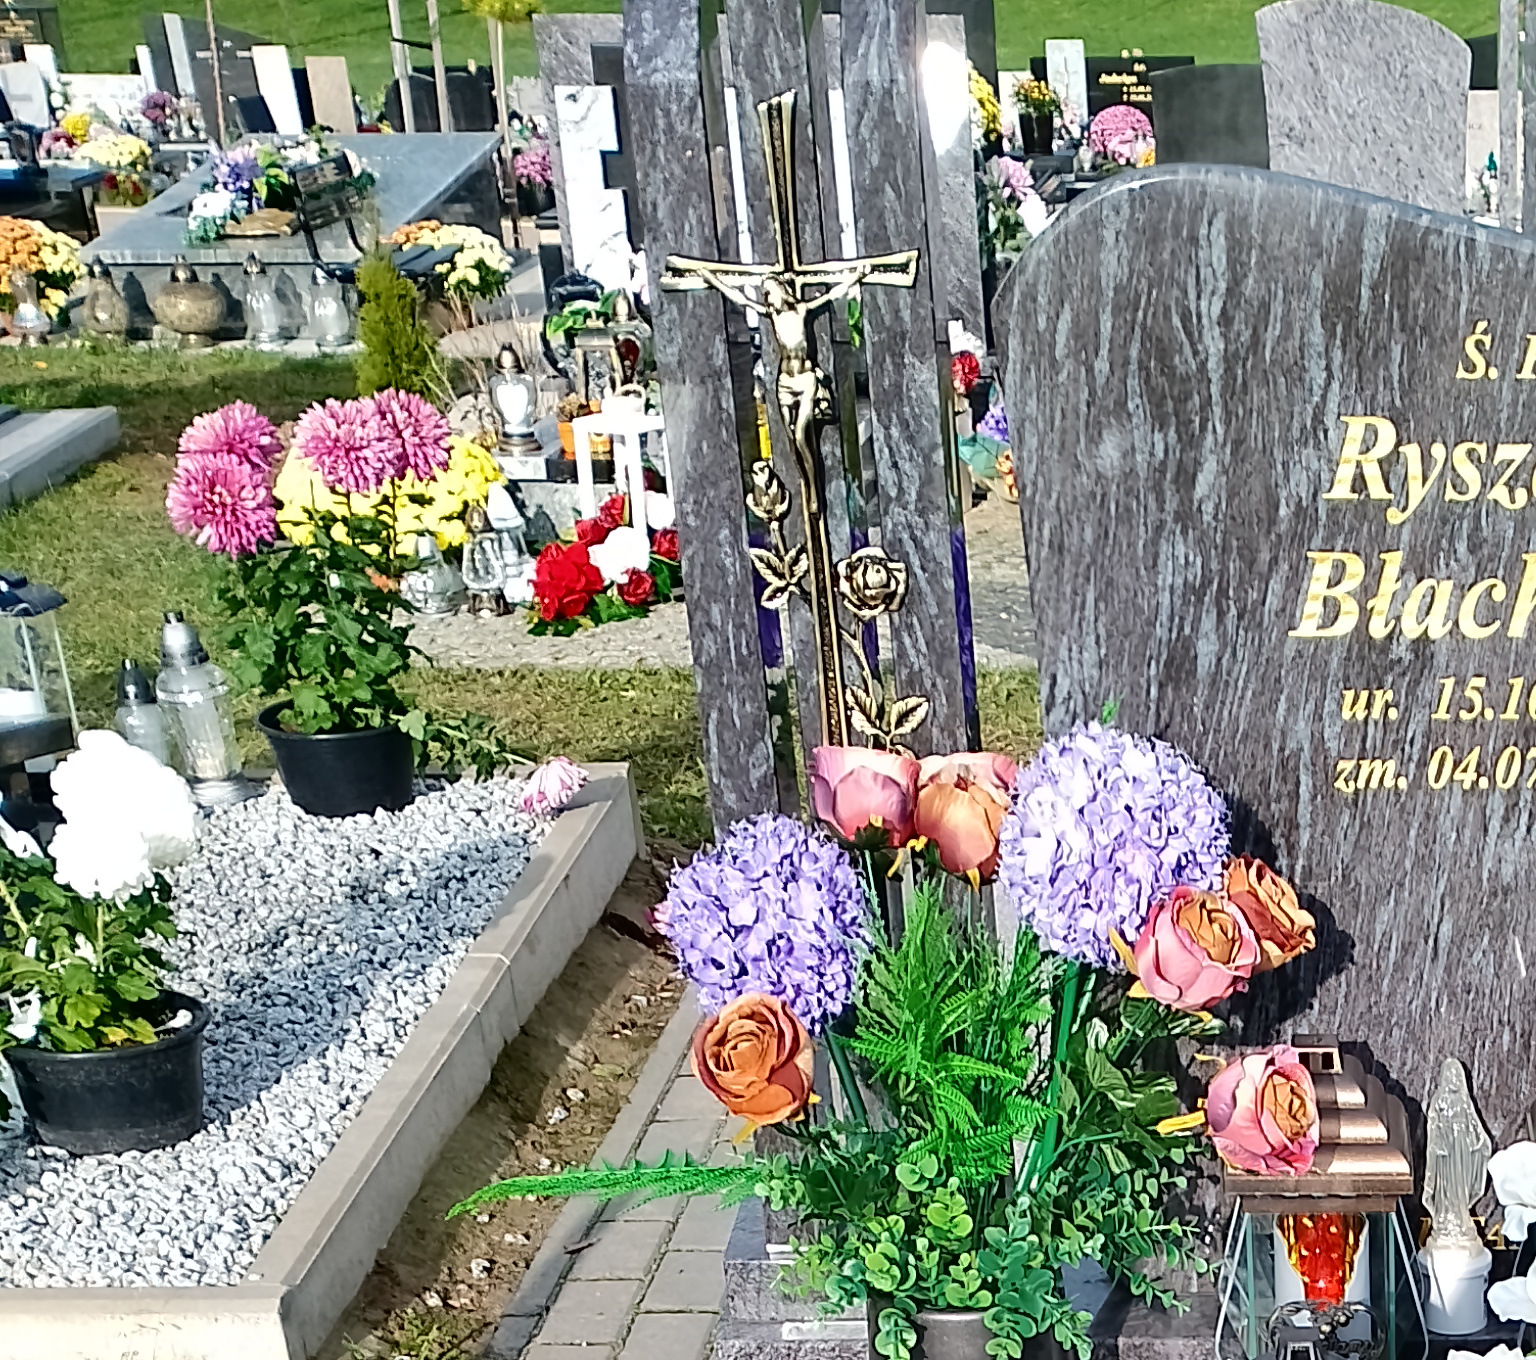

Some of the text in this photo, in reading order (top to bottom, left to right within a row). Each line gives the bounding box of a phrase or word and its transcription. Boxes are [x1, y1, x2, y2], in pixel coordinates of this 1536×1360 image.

[1456, 320, 1498, 380] Ś.
[1341, 685, 1399, 721] ur.
[1333, 756, 1408, 792] zm.
